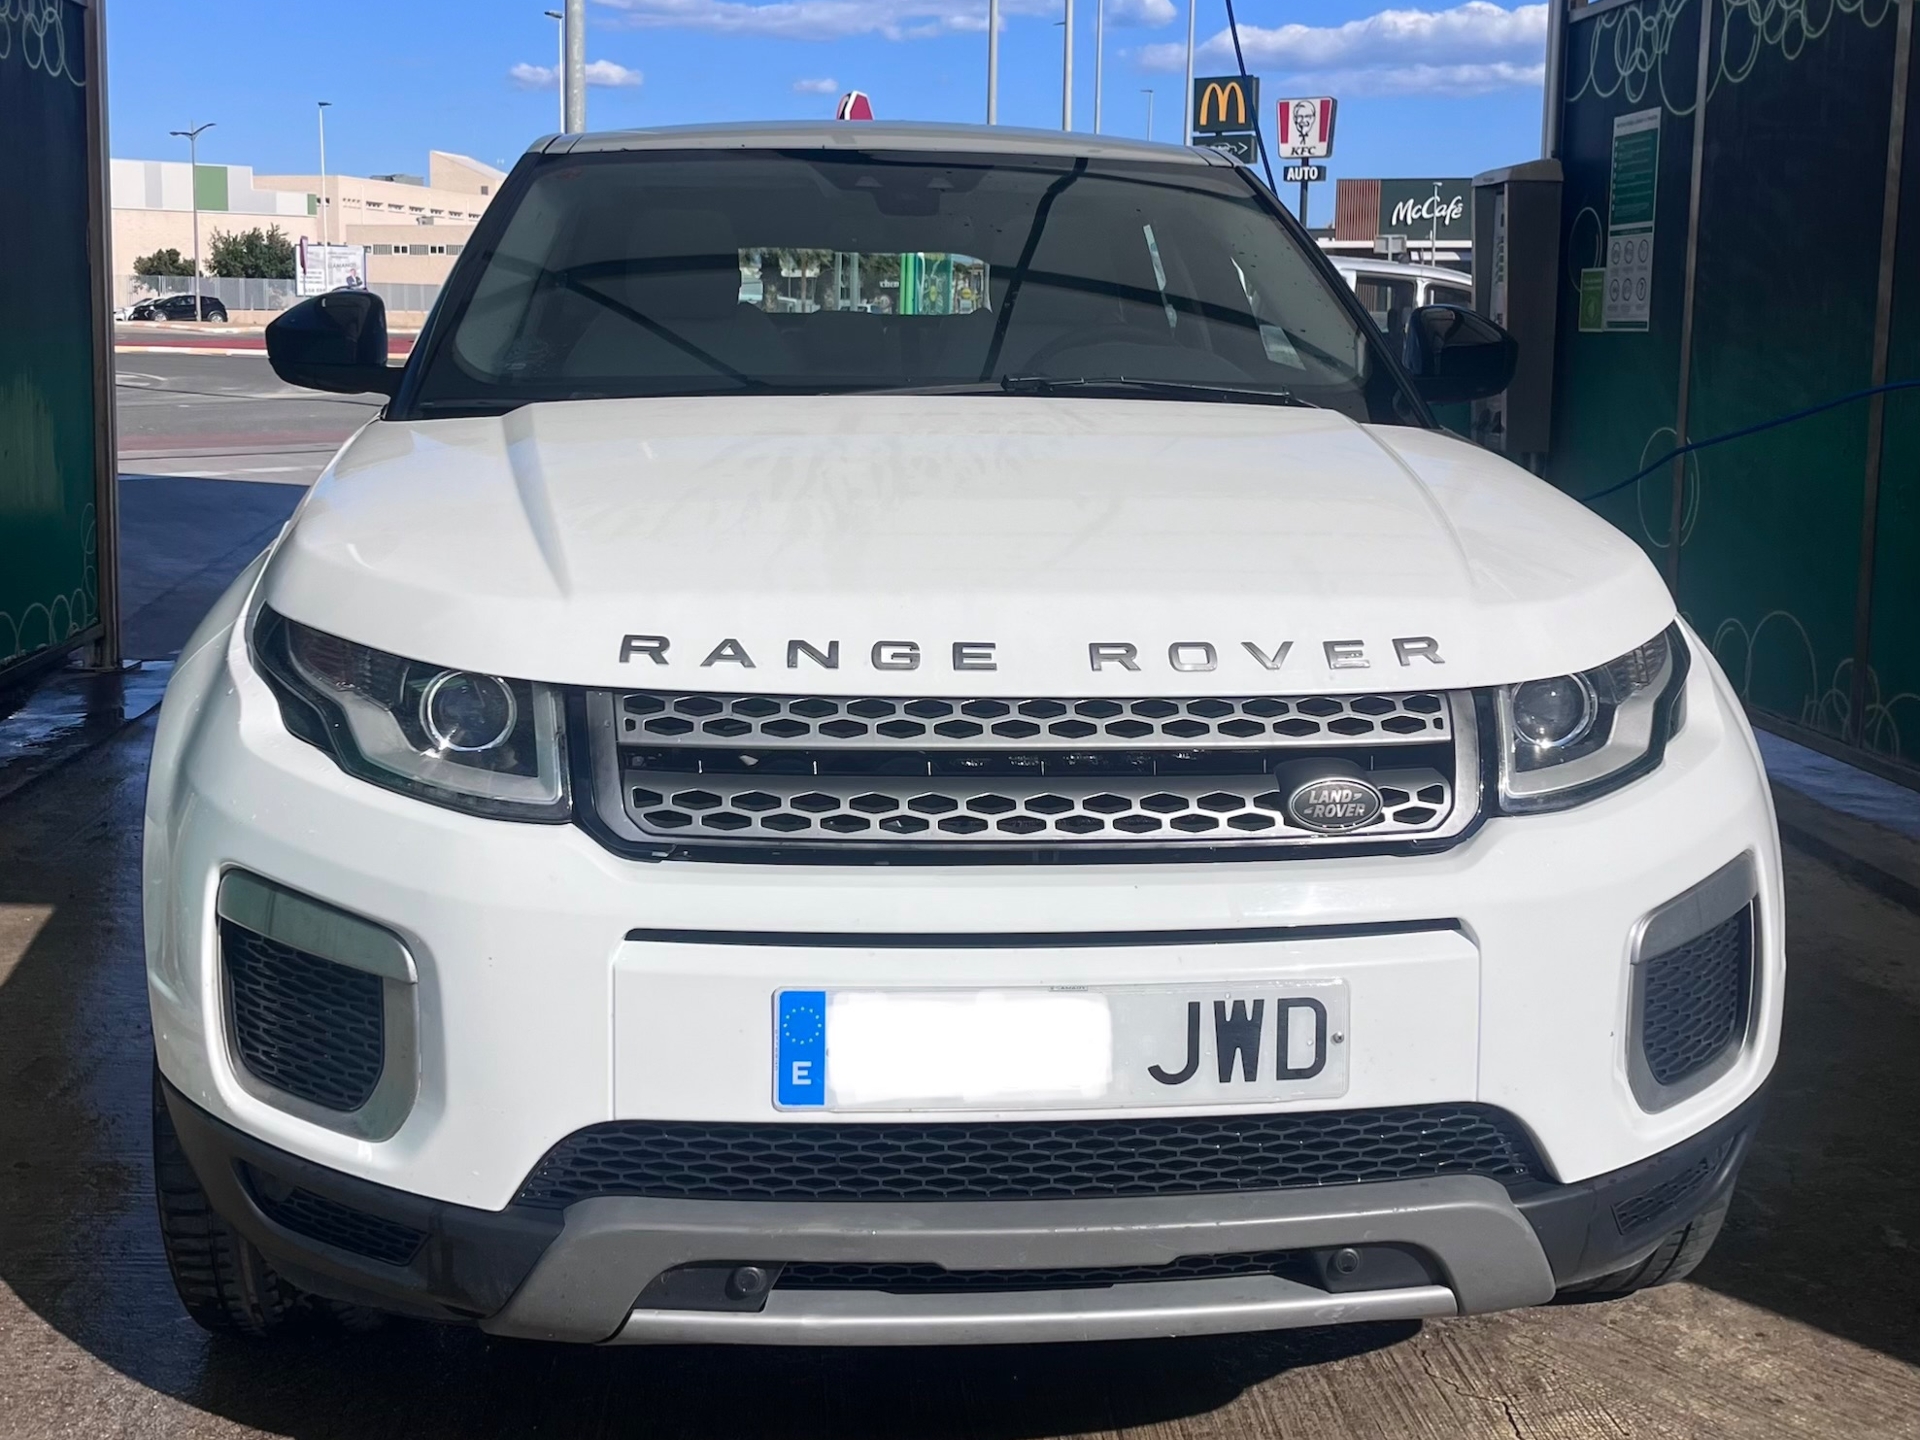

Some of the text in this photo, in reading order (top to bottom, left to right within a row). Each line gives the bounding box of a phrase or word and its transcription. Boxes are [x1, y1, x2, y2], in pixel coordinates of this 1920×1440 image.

[1290, 146, 1316, 156] KFC
[1287, 166, 1318, 181] AUTO
[1391, 195, 1463, 226] McCafé
[618, 634, 1446, 672] RANGE ROVER
[1308, 789, 1353, 804] LAND
[1312, 803, 1366, 818] ROVER
[1147, 996, 1328, 1086] JWD
[792, 1060, 812, 1085] E
